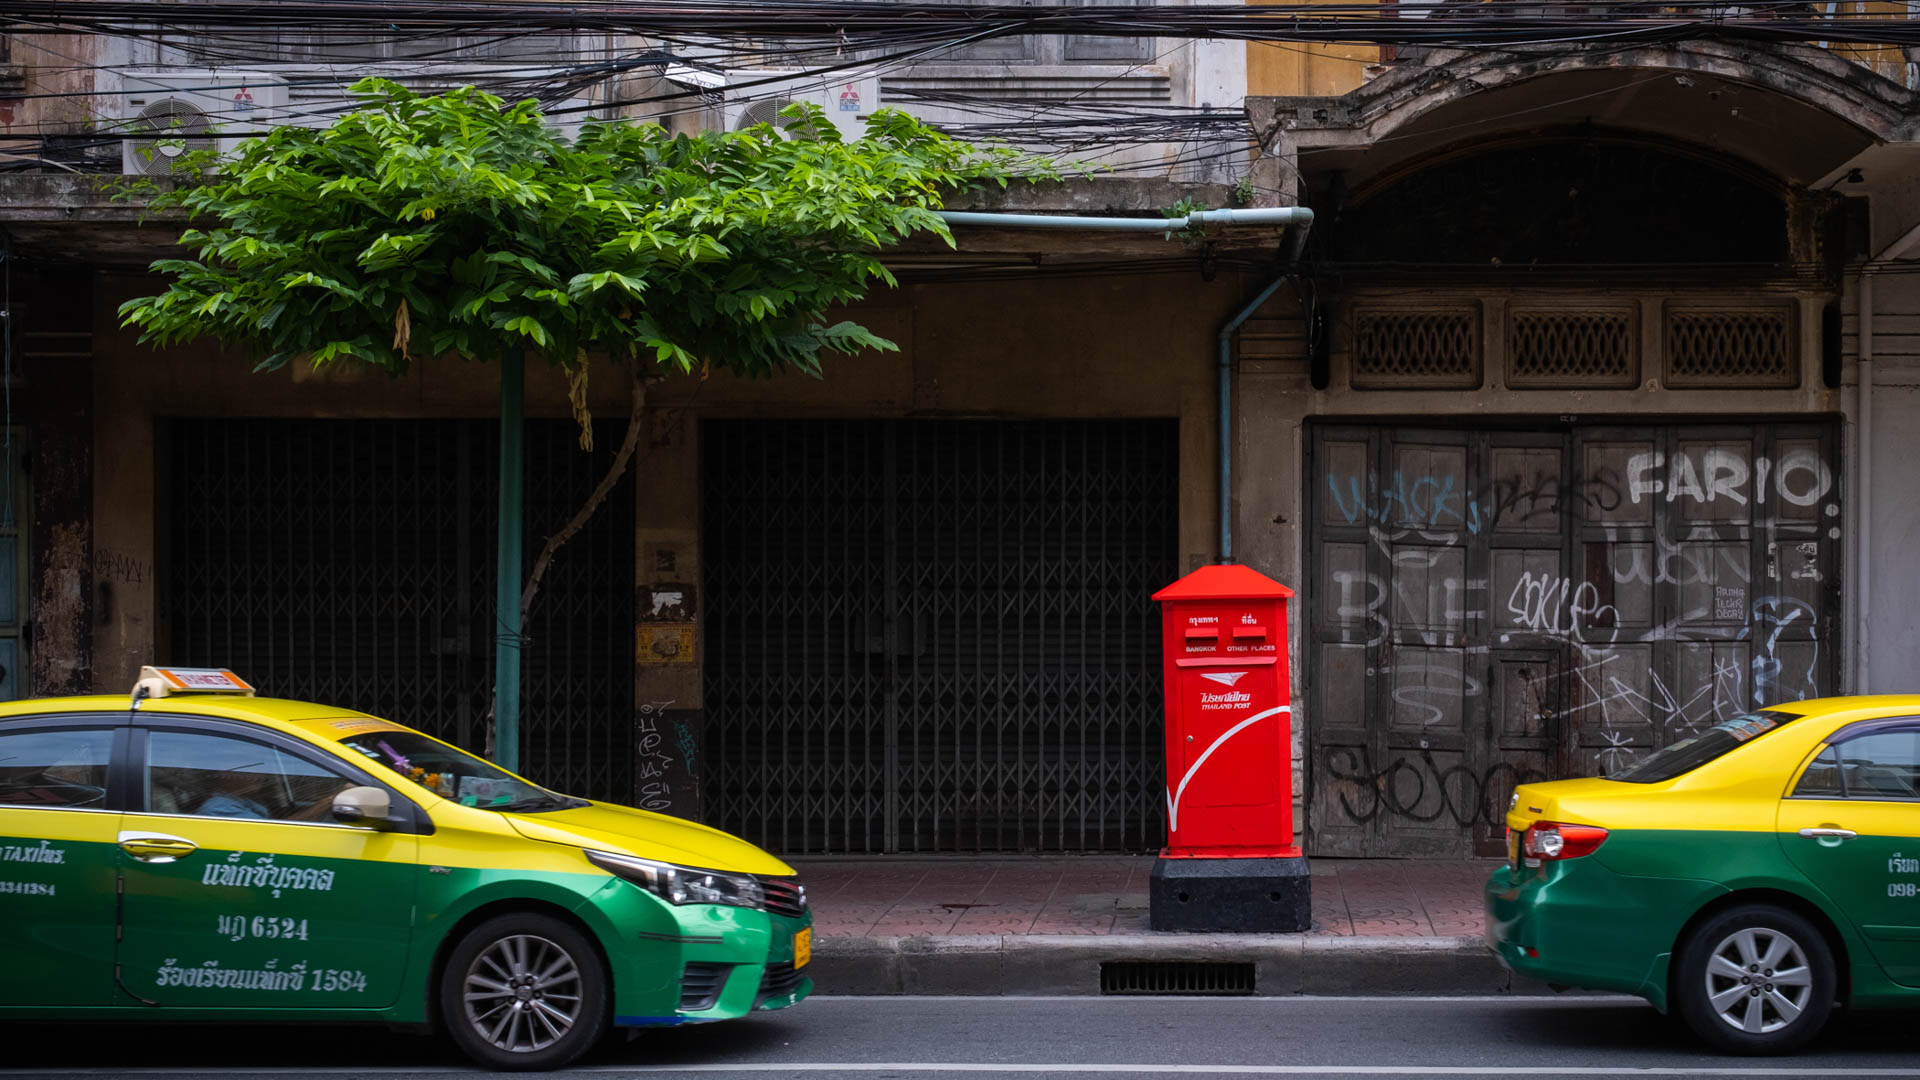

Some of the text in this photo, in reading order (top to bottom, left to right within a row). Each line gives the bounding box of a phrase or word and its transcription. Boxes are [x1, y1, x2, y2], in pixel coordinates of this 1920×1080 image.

[1188, 612, 1257, 626] กรุงเทพฯ ที่อื่น
[1202, 702, 1252, 711] THAILAND POST
[251, 915, 309, 941] 6524
[311, 969, 367, 992] 1584
